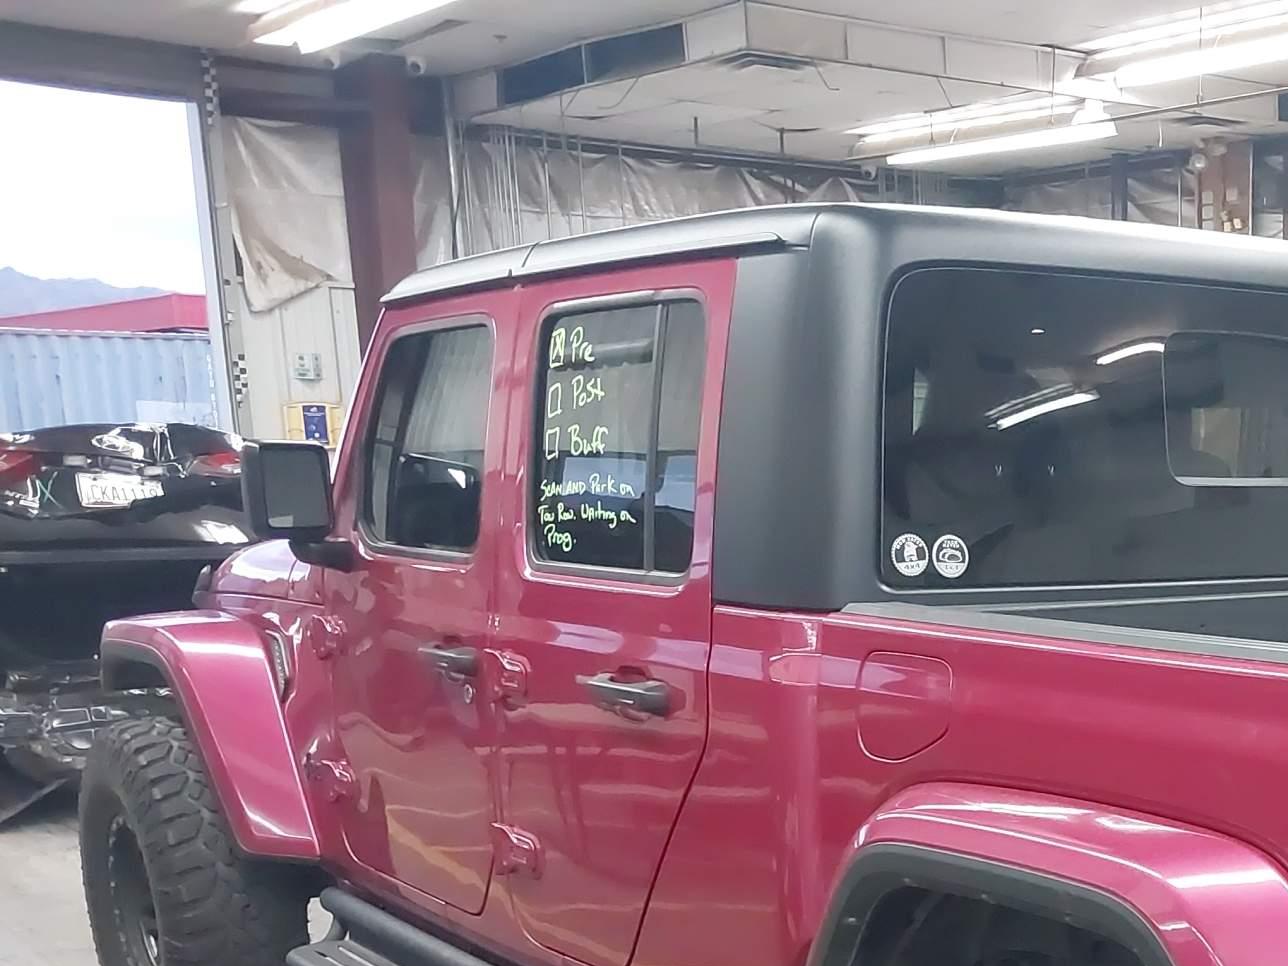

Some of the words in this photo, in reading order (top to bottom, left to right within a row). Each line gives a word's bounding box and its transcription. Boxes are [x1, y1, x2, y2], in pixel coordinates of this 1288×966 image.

[570, 326, 596, 363] Pre
[571, 374, 606, 410] Post
[567, 423, 609, 457] Buff
[564, 480, 587, 496] AND
[619, 483, 636, 498] on
[537, 504, 556, 526] Tow
[620, 509, 637, 524] on
[543, 523, 577, 552] Prog.
